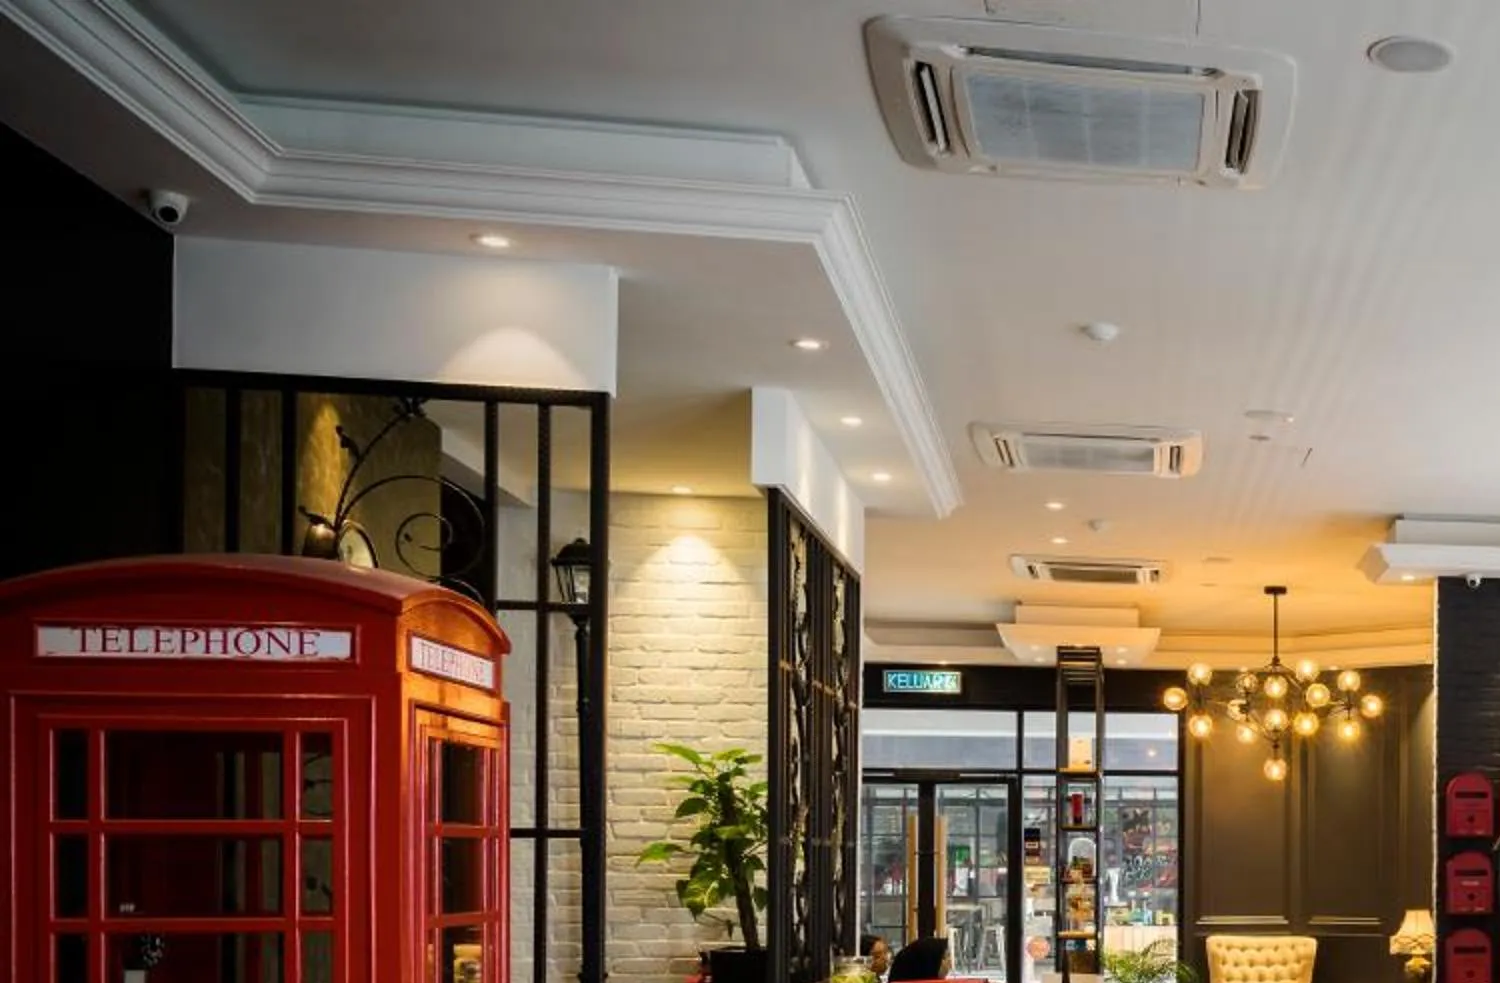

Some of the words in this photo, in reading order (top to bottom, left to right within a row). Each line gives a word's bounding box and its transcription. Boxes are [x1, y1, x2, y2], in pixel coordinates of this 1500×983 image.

[71, 625, 320, 657] TELEPHONE
[418, 641, 485, 682] TELEPHONE
[887, 673, 942, 689] KELUAR
